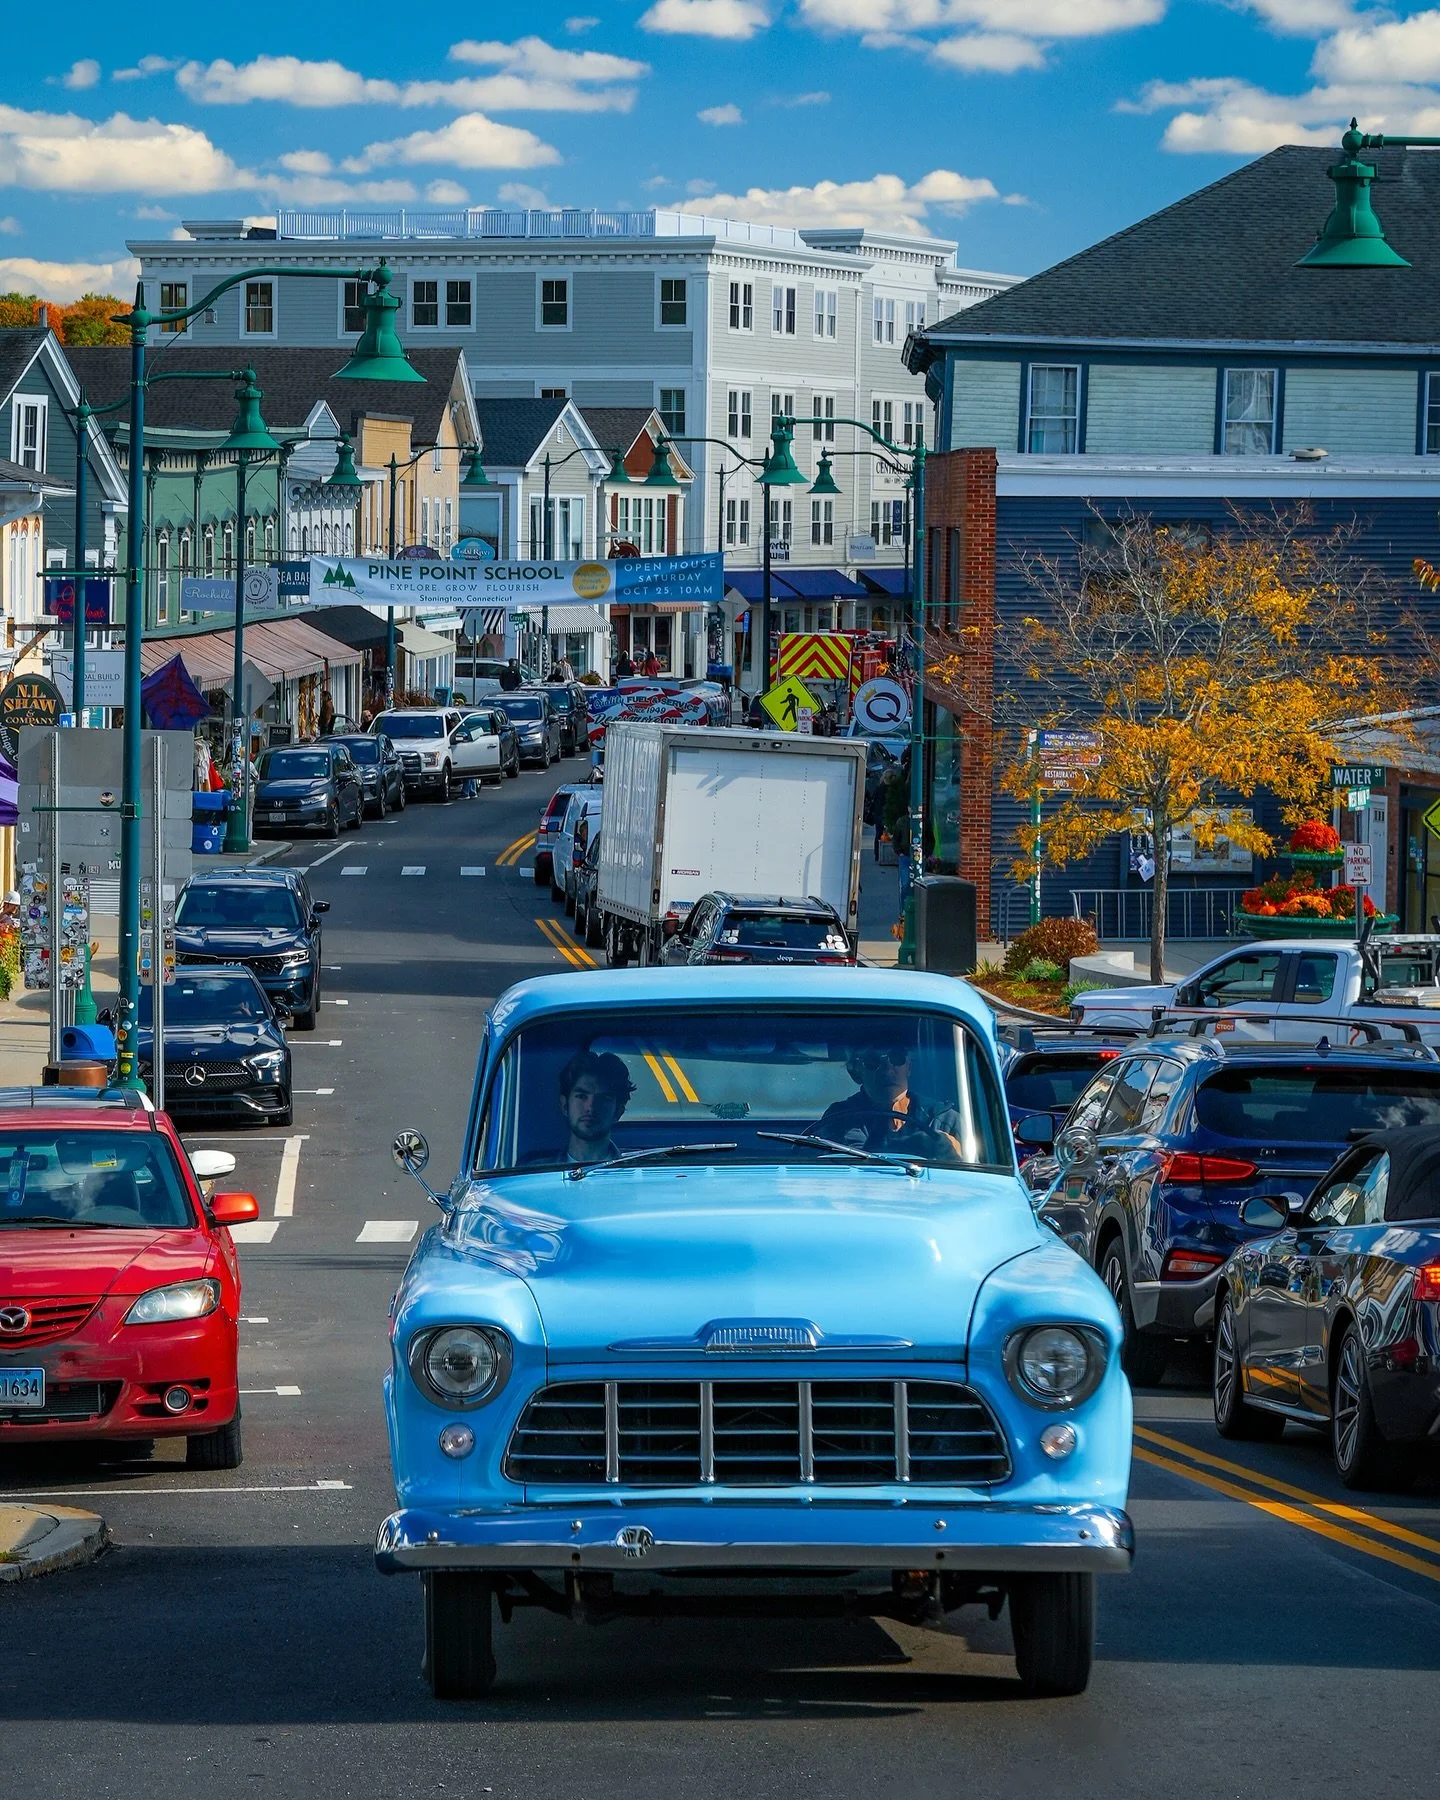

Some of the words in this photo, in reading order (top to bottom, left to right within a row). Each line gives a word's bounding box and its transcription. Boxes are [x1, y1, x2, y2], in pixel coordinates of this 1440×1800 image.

[624, 563, 662, 572] OPEN
[670, 560, 716, 570] HOUSE
[368, 565, 412, 580] PINE
[420, 566, 477, 580] POINT
[485, 566, 564, 580] SCHOOL
[638, 573, 701, 583] SATURDAY
[390, 583, 440, 592] EXPLORE.
[486, 583, 542, 592] FLOURISH.
[623, 587, 648, 596] OCT
[655, 586, 673, 596] 25,
[680, 586, 713, 594] 10AM
[419, 594, 464, 603] Stonington,
[466, 594, 513, 602] Connecticut
[4, 698, 57, 714] SHAW
[626, 696, 650, 704] FUEL
[660, 698, 700, 714] SERVICE
[627, 705, 645, 714] Since
[646, 706, 667, 714] 1949
[865, 691, 901, 722] Q
[26, 709, 34, 718] &
[5, 716, 55, 725] COMPANY
[1334, 768, 1372, 785] WATER
[1374, 768, 1382, 777] ST
[1353, 847, 1364, 856] NO
[1347, 857, 1370, 865] PARKING
[776, 954, 794, 962] Jeep
